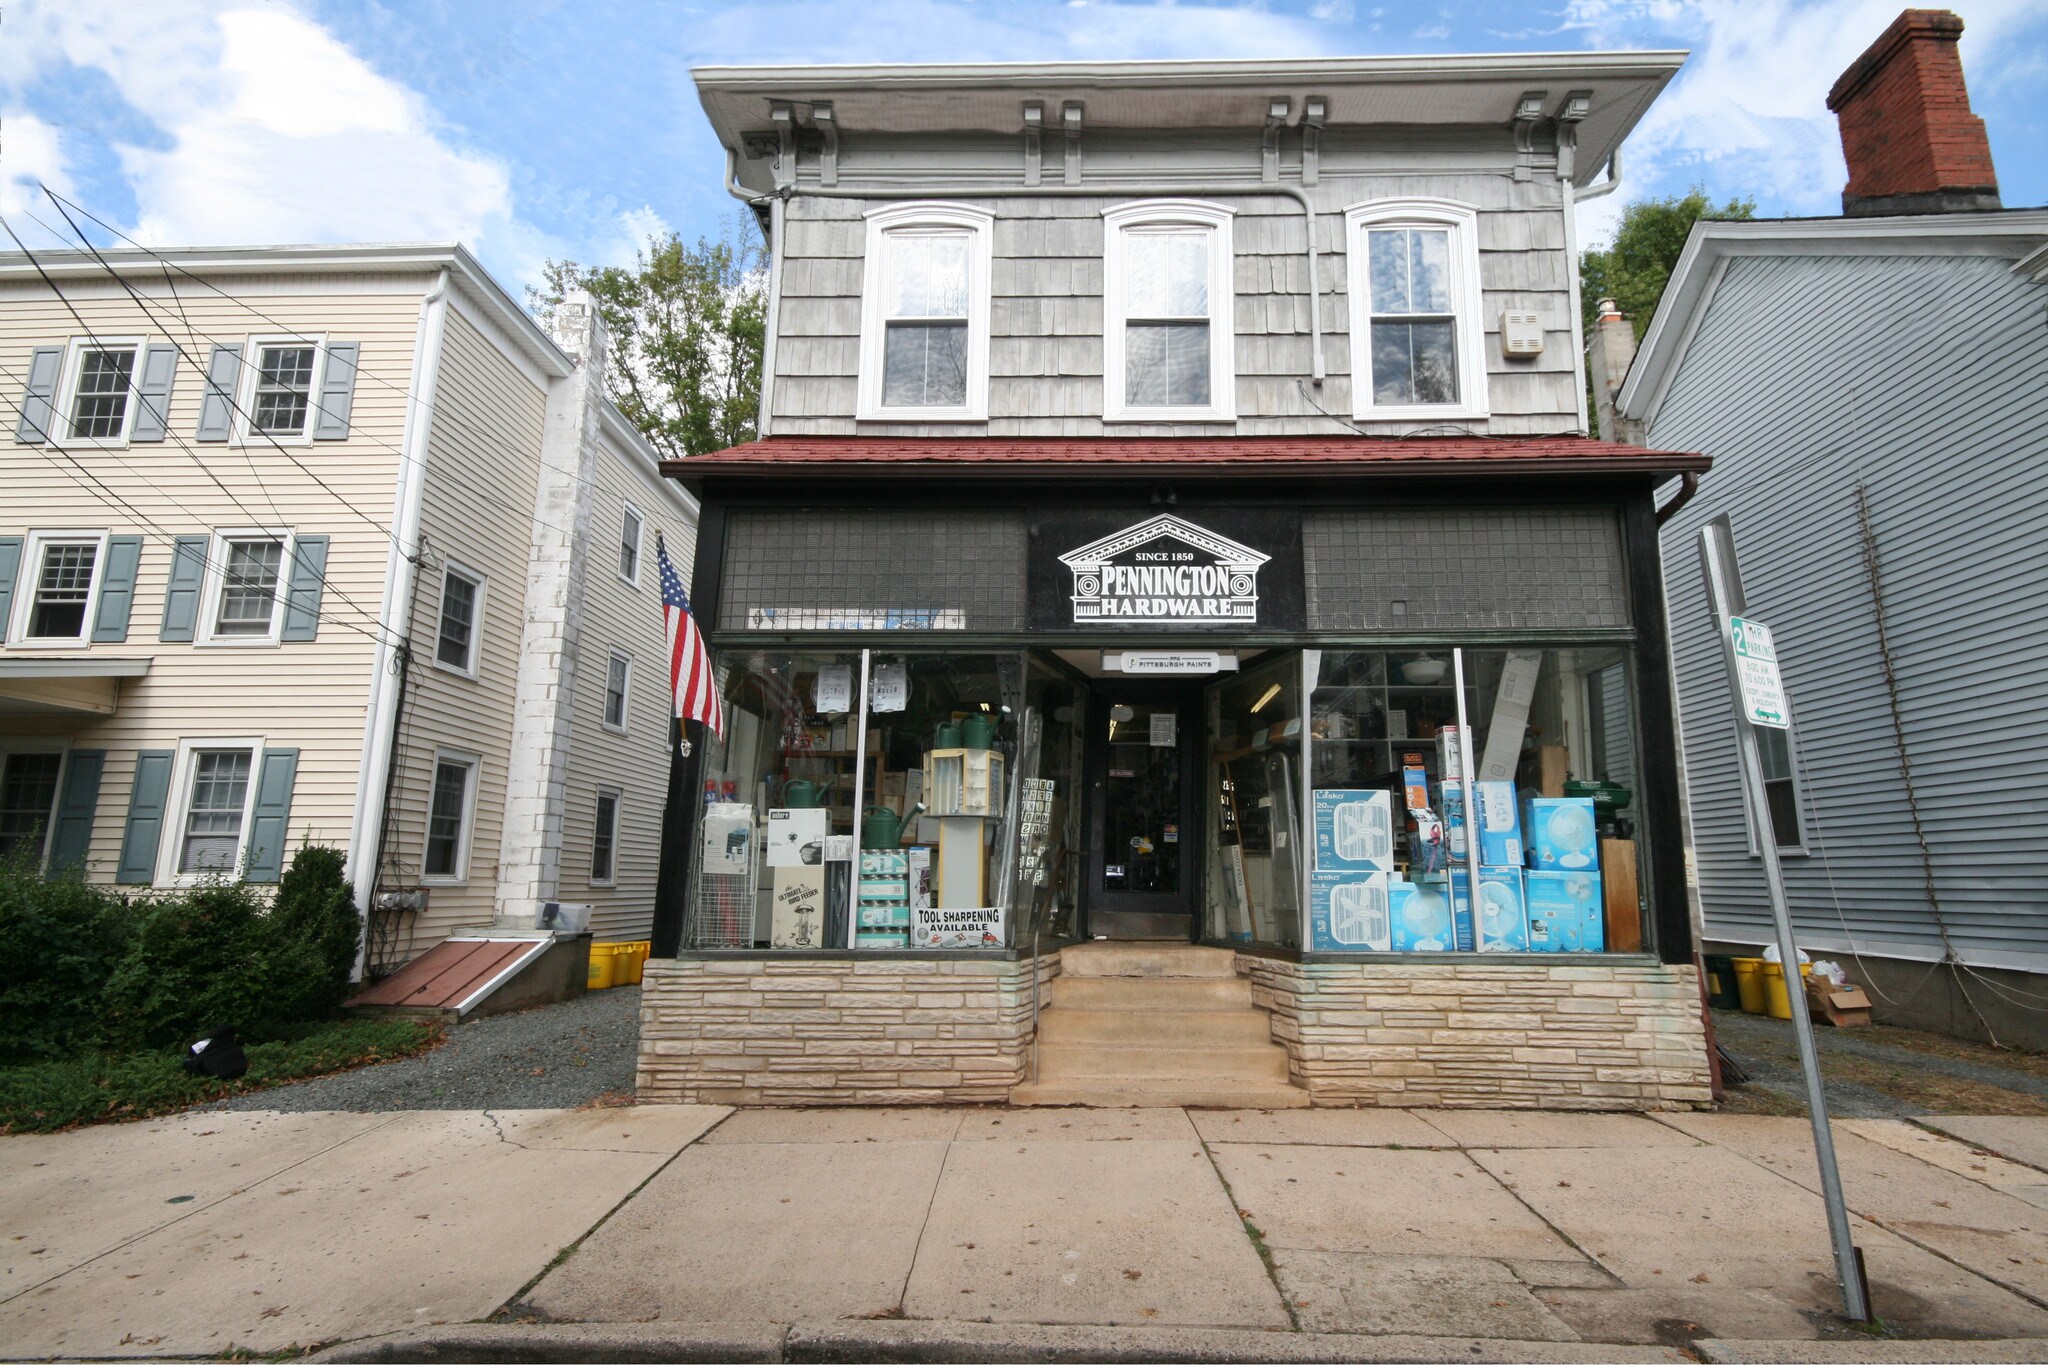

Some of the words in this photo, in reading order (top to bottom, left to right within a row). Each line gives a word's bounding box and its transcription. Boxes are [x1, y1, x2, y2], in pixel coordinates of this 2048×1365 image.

[1135, 552, 1169, 561] SINCE
[1171, 552, 1194, 561] 1850
[1100, 565, 1230, 597] PENNINGTON
[1100, 598, 1232, 616] HARDWARE
[1733, 627, 1745, 653] 2
[1751, 626, 1763, 640] HR
[1747, 641, 1773, 658] PARKING
[1760, 665, 1769, 674] AM
[1745, 672, 1753, 683] TO
[1766, 677, 1775, 688] PM
[778, 888, 801, 901] ULTIMATE
[800, 889, 819, 900] FEEDER
[918, 909, 940, 924] TOOL
[943, 908, 999, 923] SHARPENING
[929, 923, 988, 932] AVAILABLE
